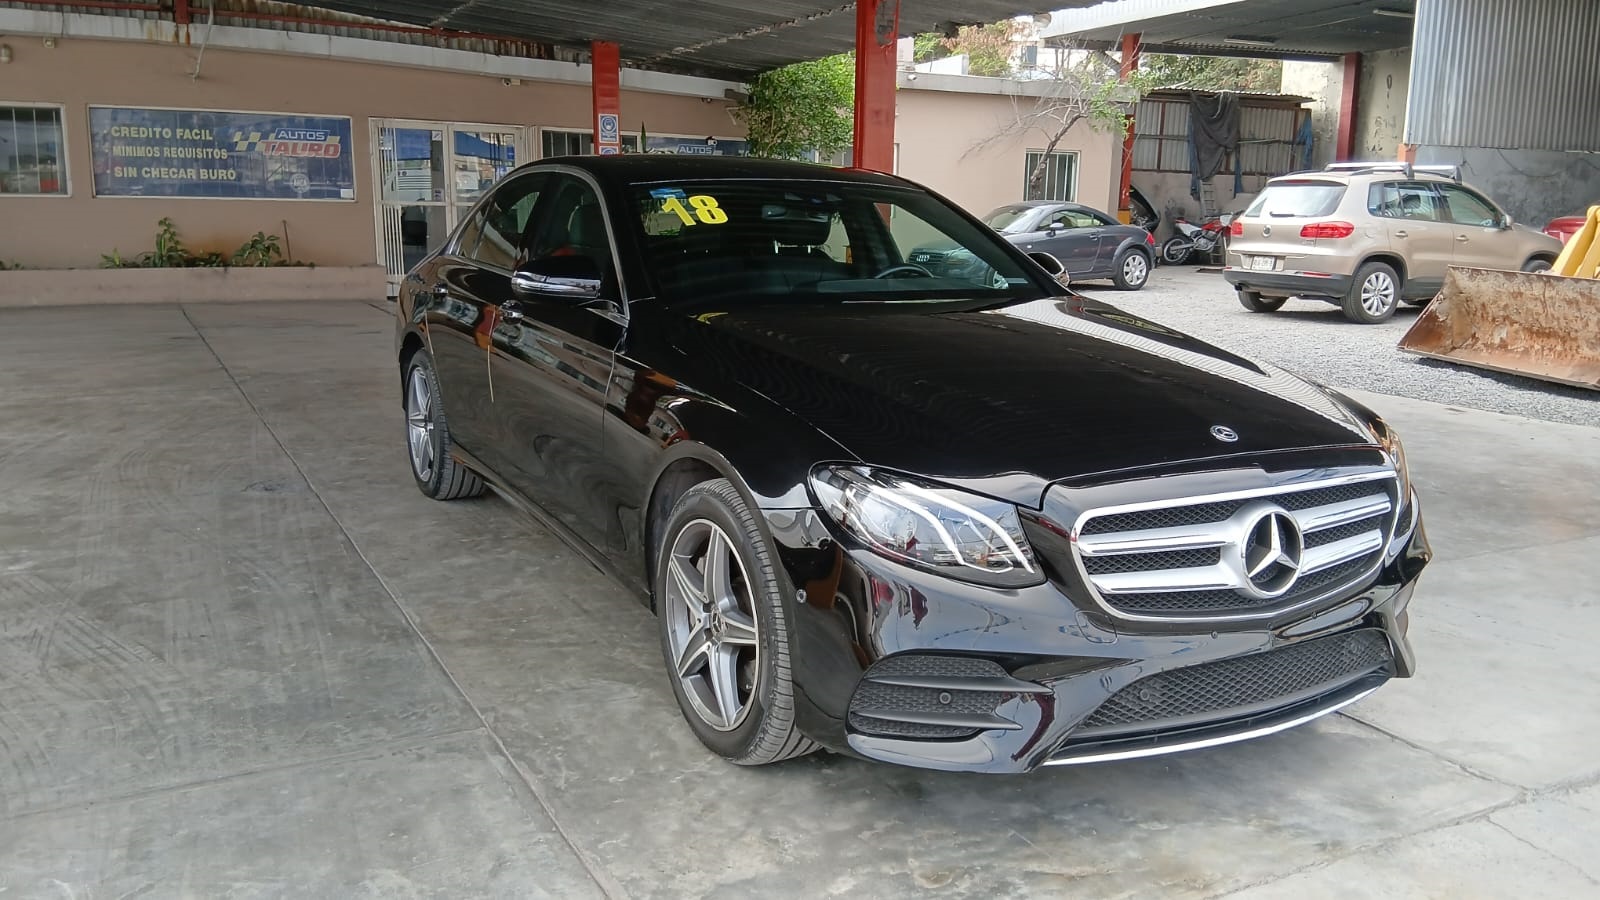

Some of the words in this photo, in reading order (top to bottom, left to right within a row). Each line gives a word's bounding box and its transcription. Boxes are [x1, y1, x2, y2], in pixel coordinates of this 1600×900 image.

[111, 126, 172, 139] CREDITO
[176, 128, 213, 140] FACIL
[278, 130, 325, 141] AUTOS
[112, 145, 161, 157] MINIMOS
[163, 147, 228, 160] REQUISITOS
[261, 140, 341, 158] TAURO
[679, 146, 714, 154] AUTOS
[114, 166, 137, 178] SIN
[141, 167, 196, 179] CHECAR
[661, 195, 729, 226] 18
